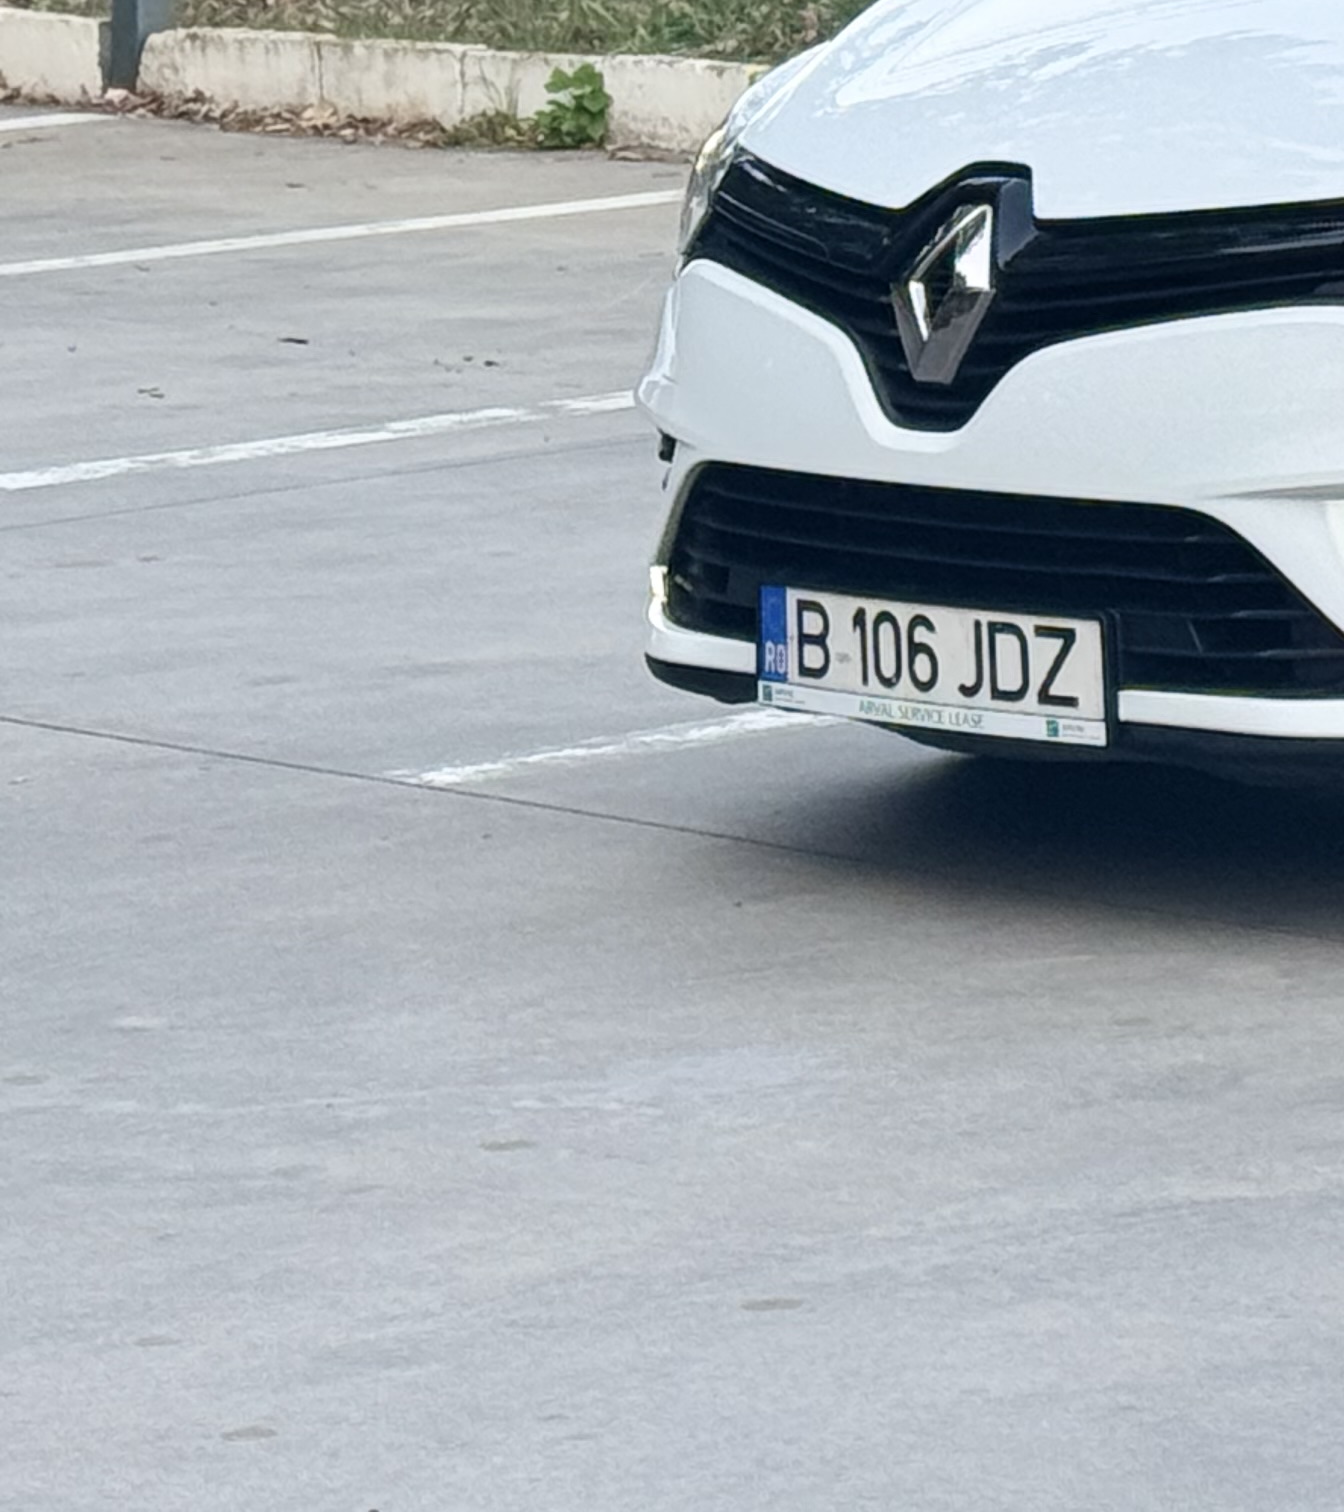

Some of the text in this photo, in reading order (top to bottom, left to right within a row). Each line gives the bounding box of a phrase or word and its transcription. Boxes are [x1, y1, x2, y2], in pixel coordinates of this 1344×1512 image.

[765, 640, 786, 674] RO
[797, 599, 1079, 707] B 106 JDZ
[897, 702, 945, 725] SERVICE
[948, 710, 985, 729] LEASE
